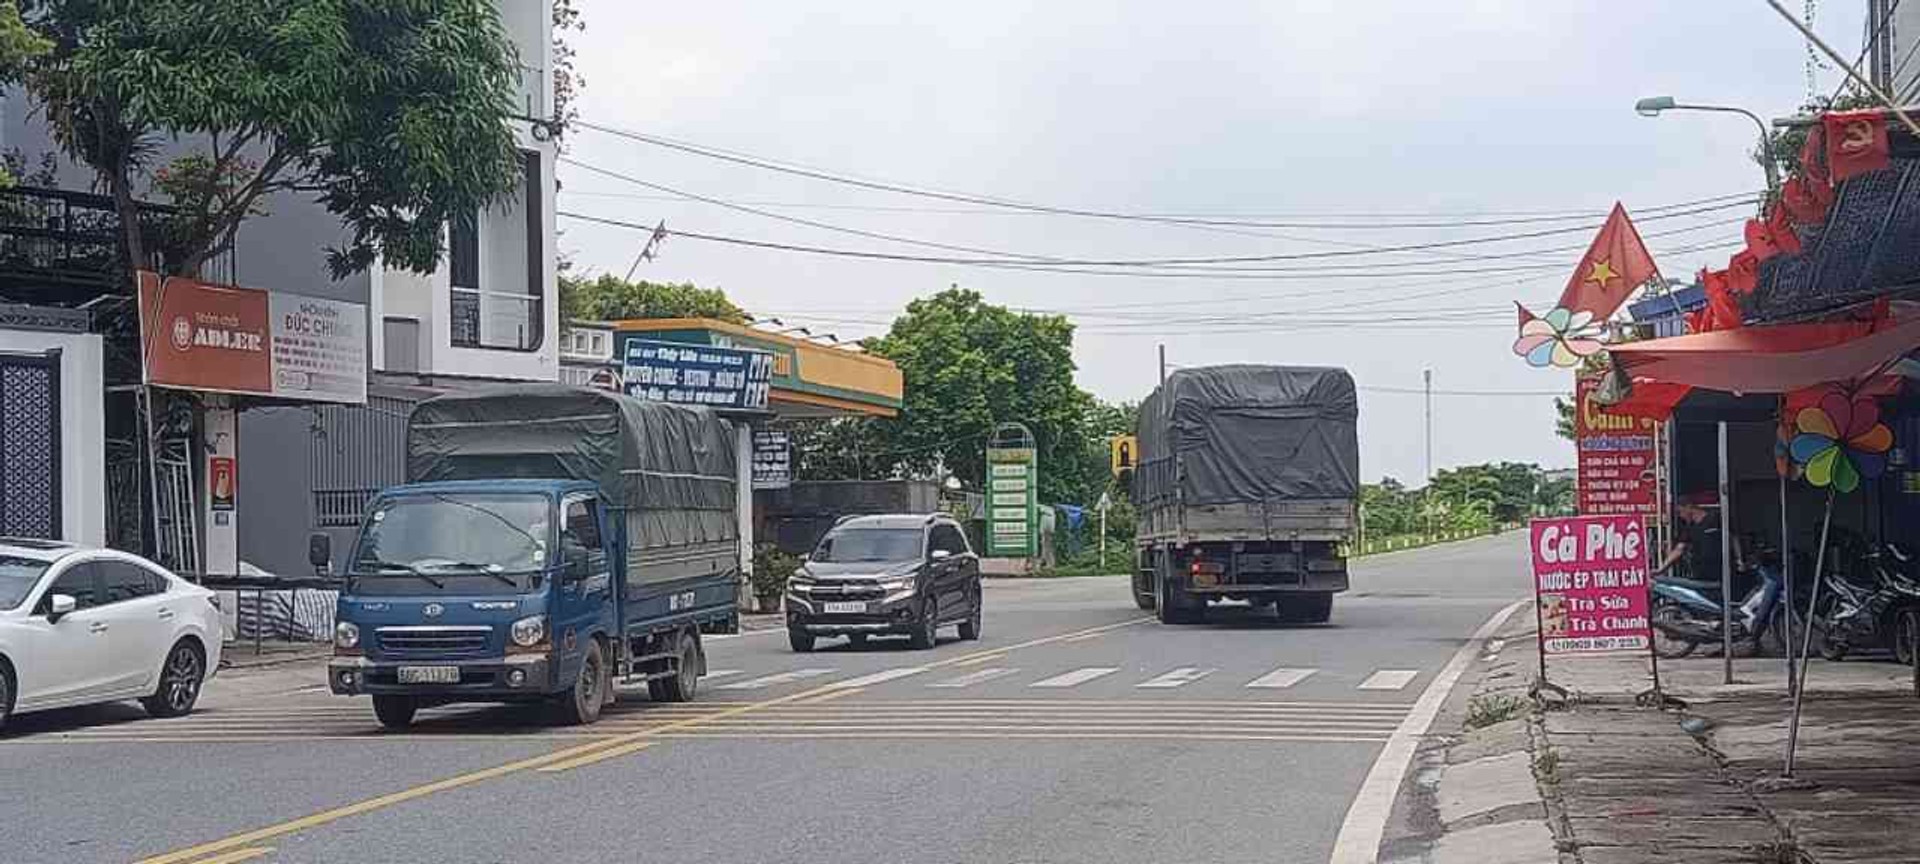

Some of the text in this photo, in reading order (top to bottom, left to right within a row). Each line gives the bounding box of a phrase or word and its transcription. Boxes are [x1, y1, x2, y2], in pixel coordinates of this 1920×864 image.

[193, 327, 263, 351] ADLER
[1539, 520, 1641, 563] Cà Phê
[1538, 572, 1571, 591] NƯỚC
[1573, 569, 1590, 589] ÉP
[1621, 565, 1645, 586] CÂY
[1600, 594, 1629, 610] Sữa
[1571, 614, 1648, 631] Trà Chanh
